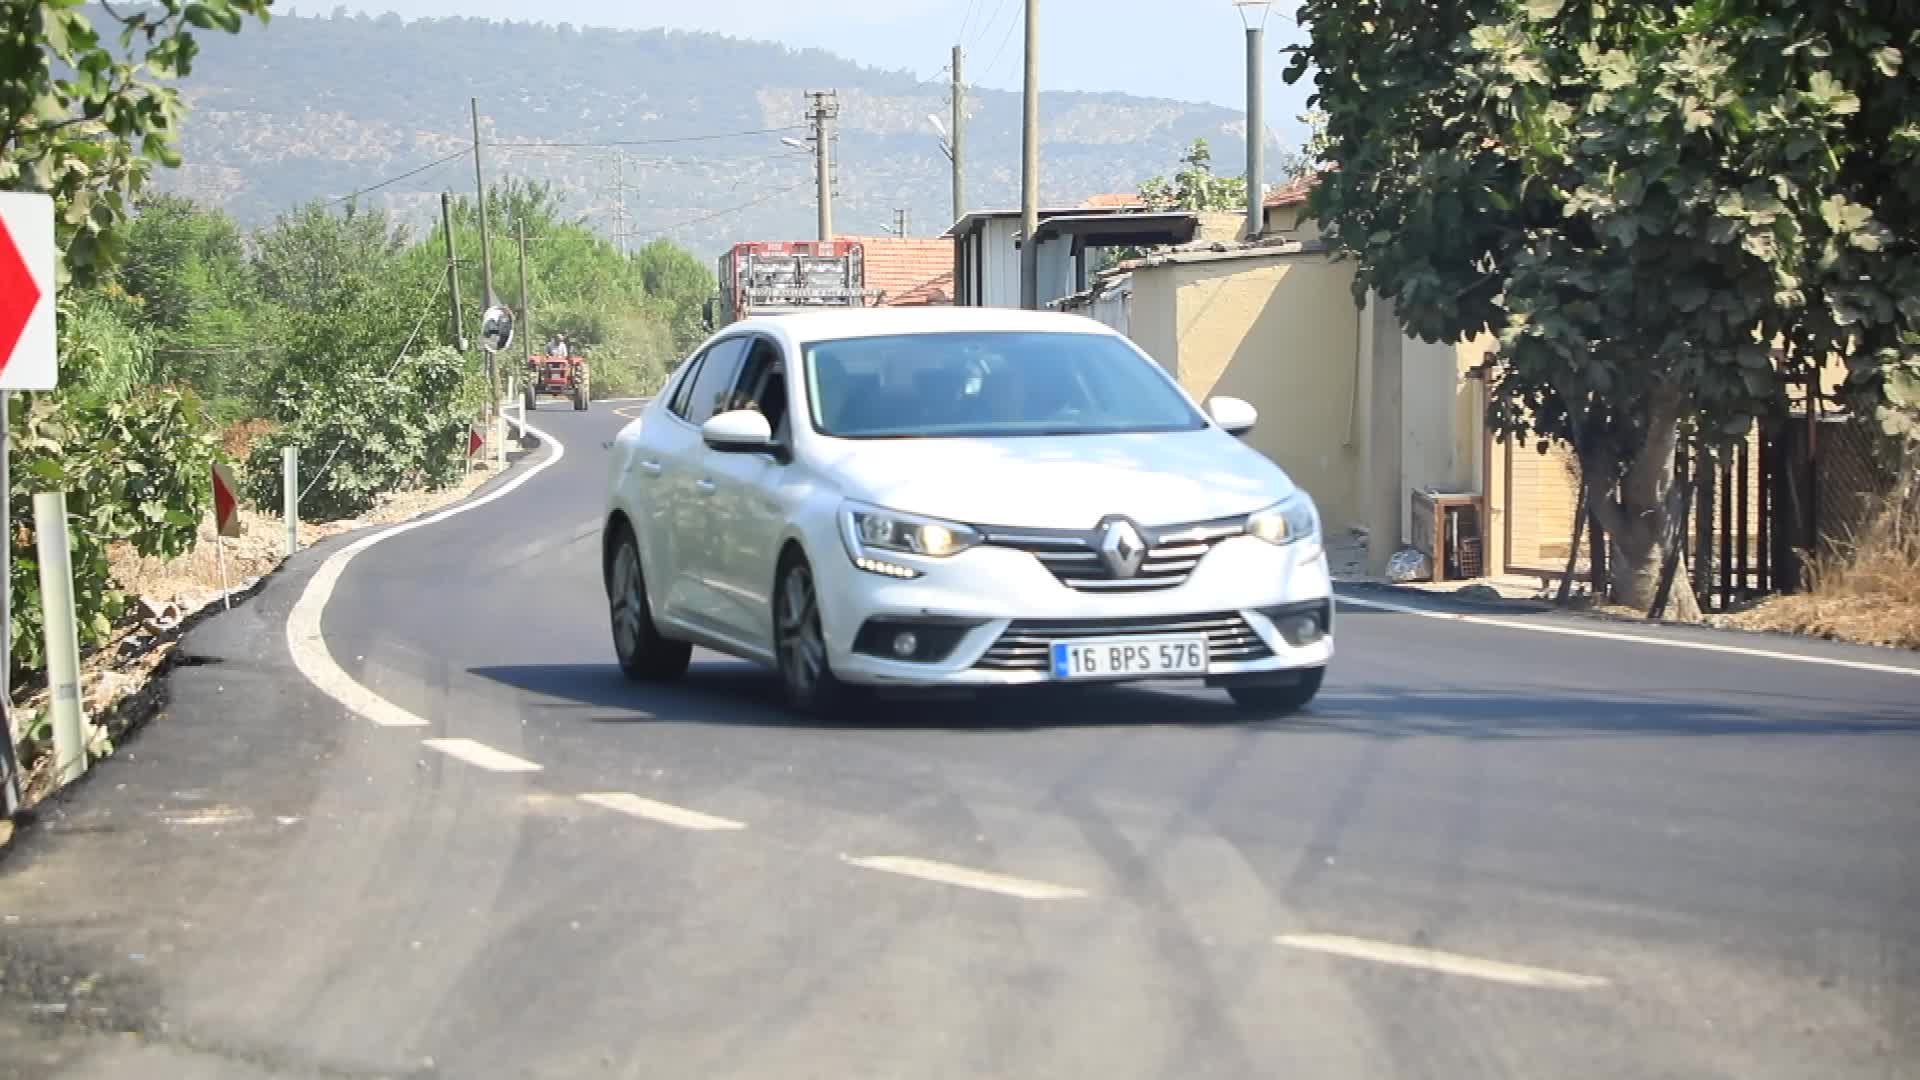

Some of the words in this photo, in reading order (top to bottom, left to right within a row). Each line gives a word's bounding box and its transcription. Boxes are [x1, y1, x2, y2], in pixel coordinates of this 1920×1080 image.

[1072, 647, 1097, 672] 16
[1109, 646, 1151, 671] BPS
[1159, 643, 1200, 669] 576
